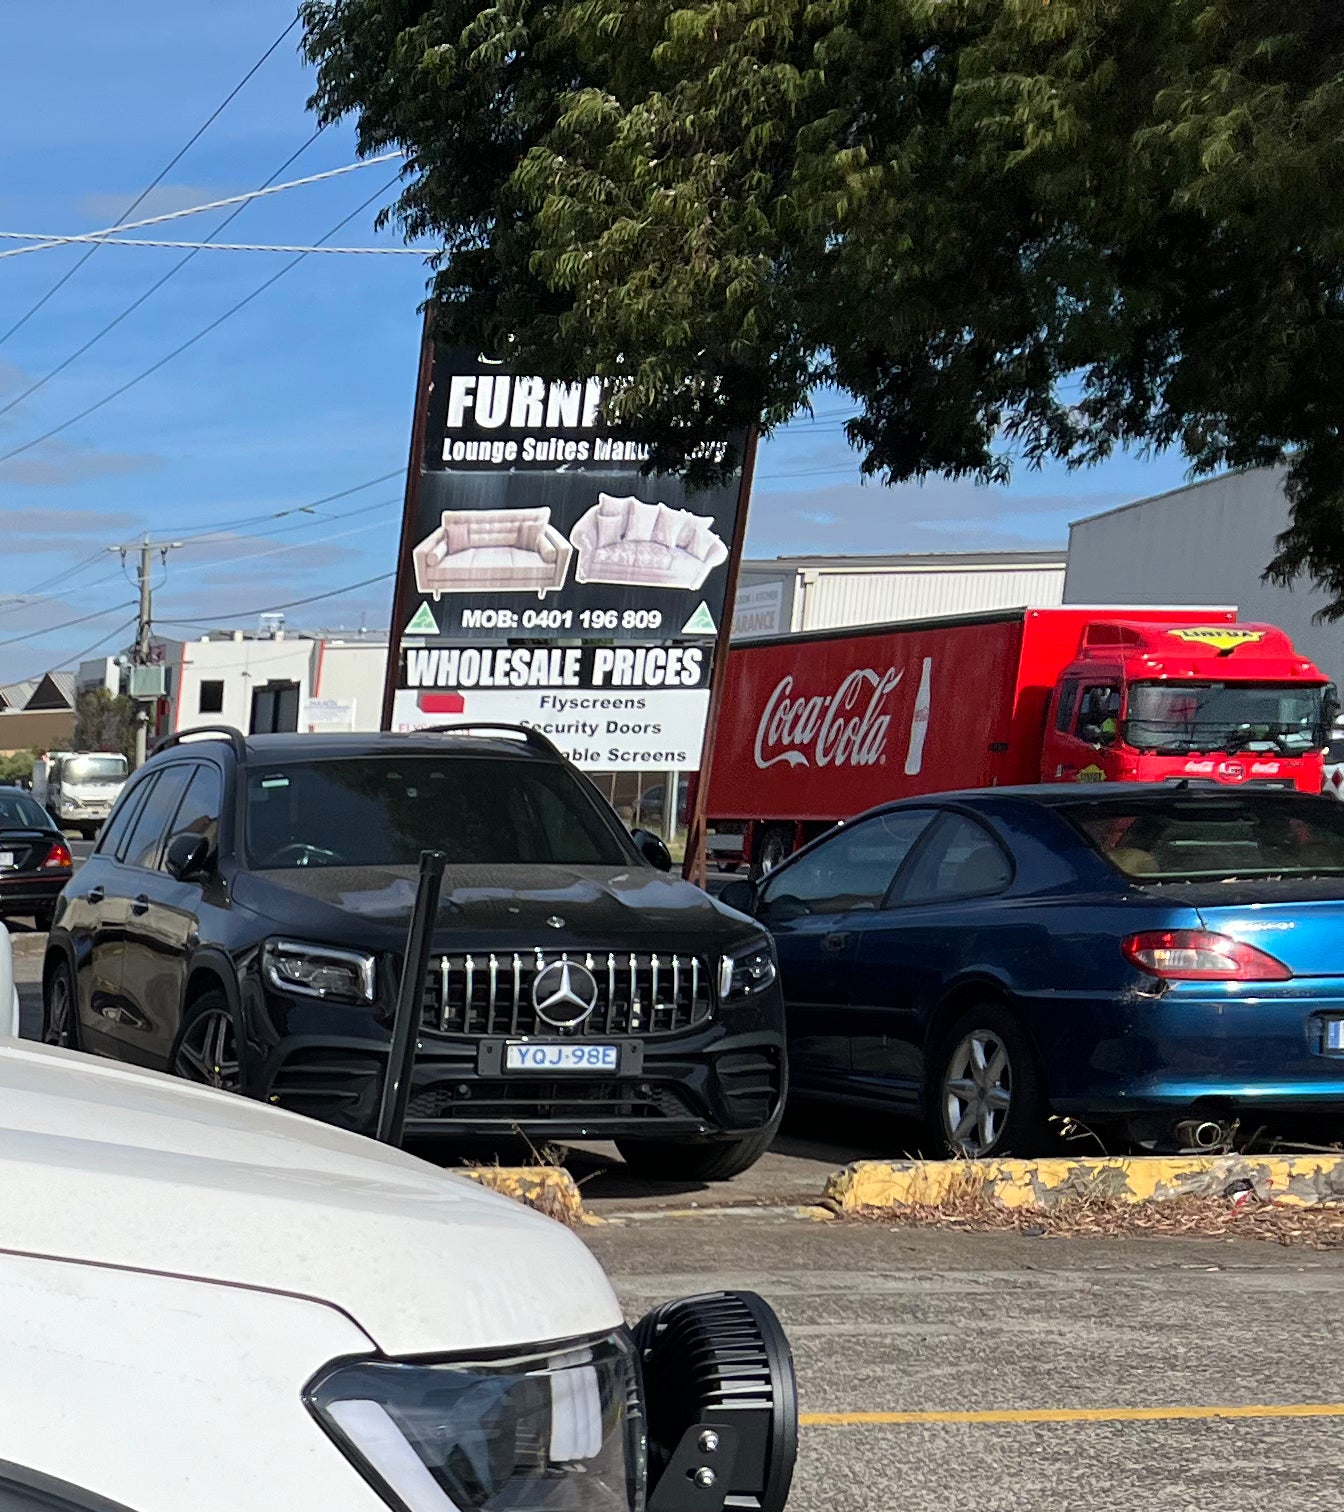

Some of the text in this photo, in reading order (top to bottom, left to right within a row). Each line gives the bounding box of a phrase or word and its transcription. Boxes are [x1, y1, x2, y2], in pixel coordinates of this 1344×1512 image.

[441, 437, 517, 463] Lounge
[522, 437, 590, 461] Suites
[462, 609, 662, 629] MOB: 0401 196 809
[406, 647, 703, 687] WHOLESALE PRICES
[539, 695, 647, 712] Flyscreens
[605, 720, 663, 735] Doors
[607, 747, 687, 763] Screens
